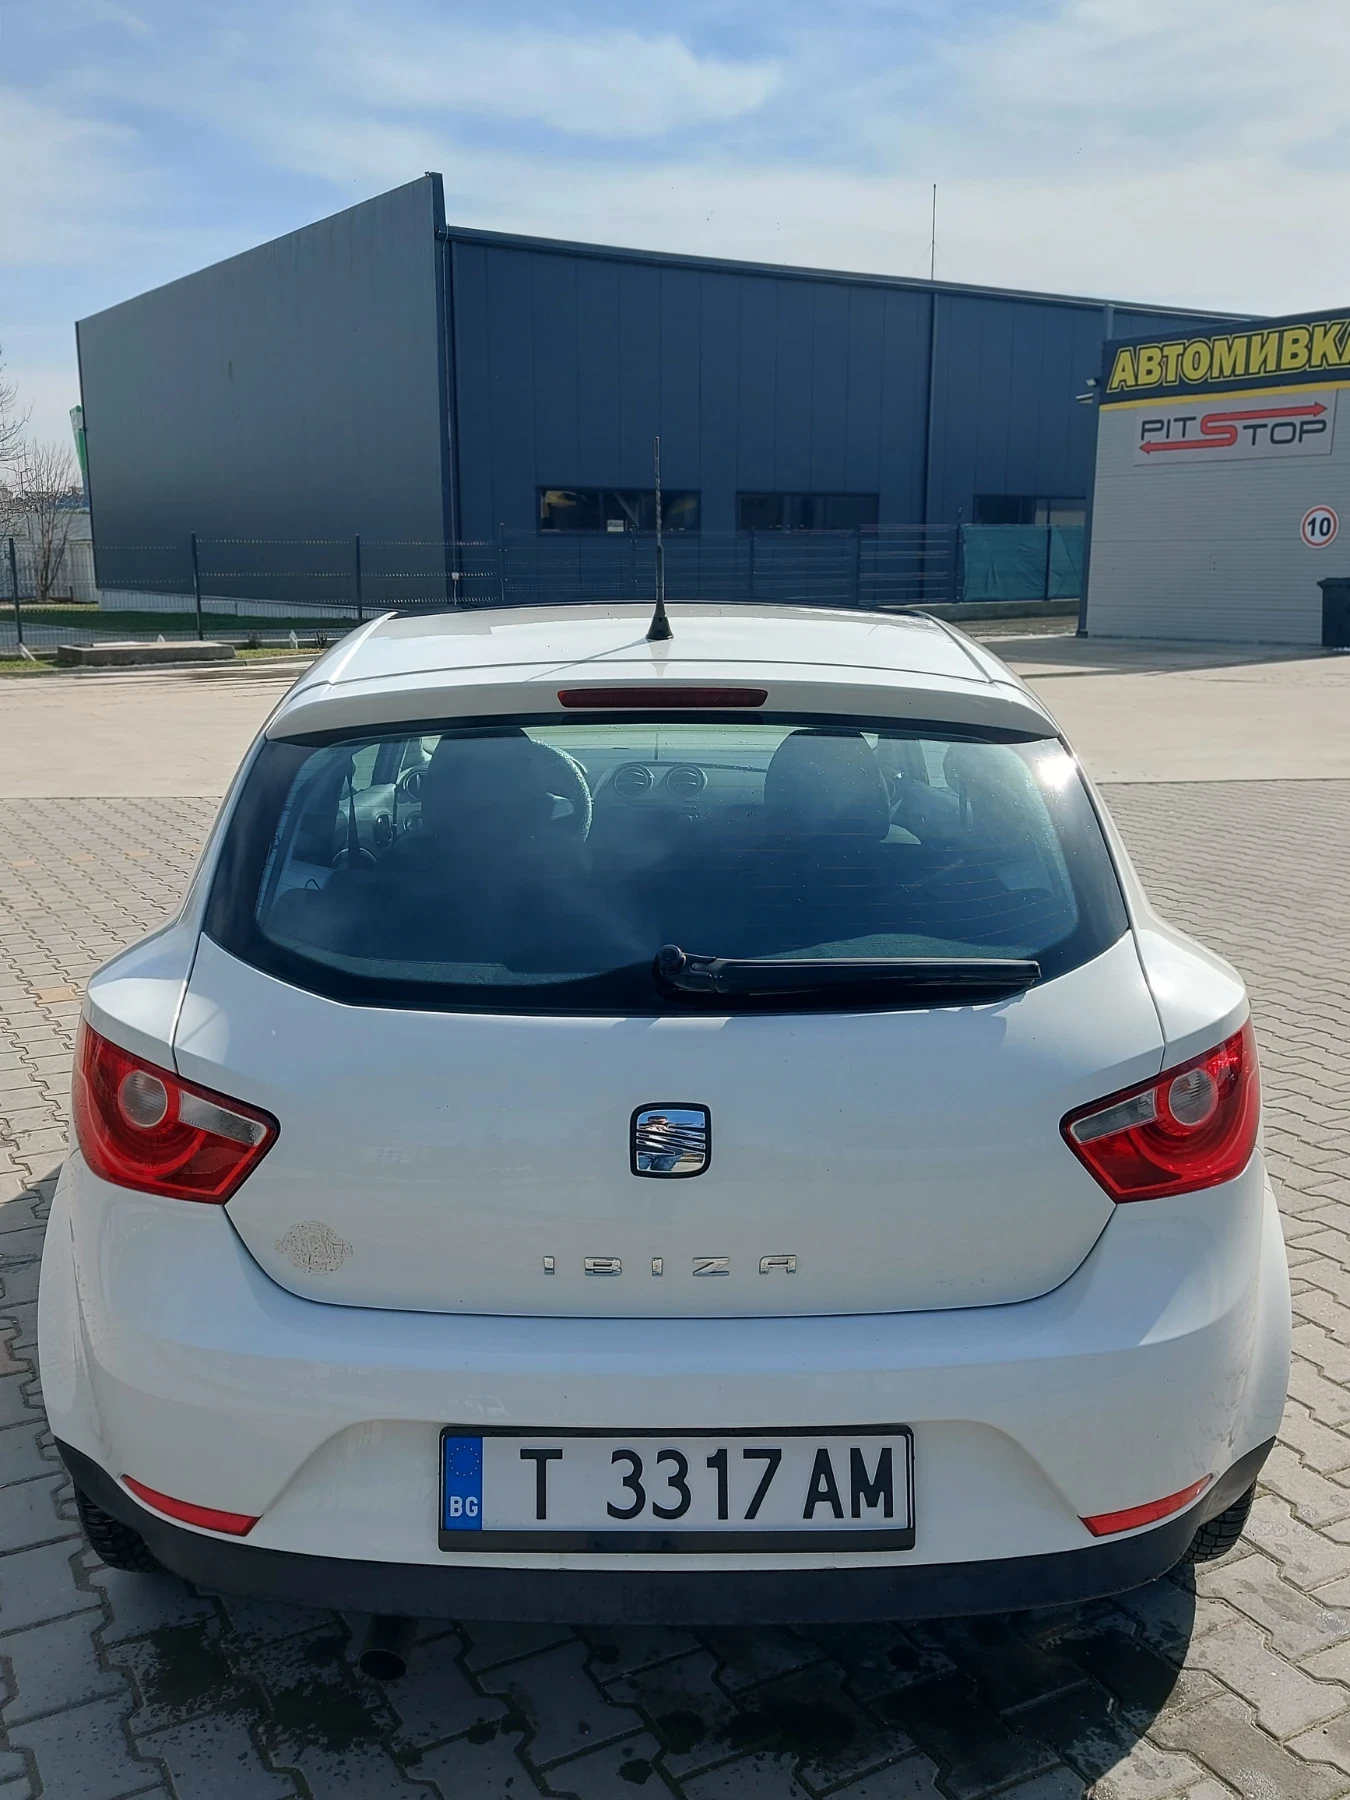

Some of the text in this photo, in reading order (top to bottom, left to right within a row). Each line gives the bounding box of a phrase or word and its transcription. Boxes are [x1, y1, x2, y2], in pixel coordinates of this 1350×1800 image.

[1307, 516, 1331, 537] 10
[543, 1254, 797, 1276] IBIZA
[519, 1447, 894, 1520] T 3317 AM
[449, 1496, 479, 1518] BG
